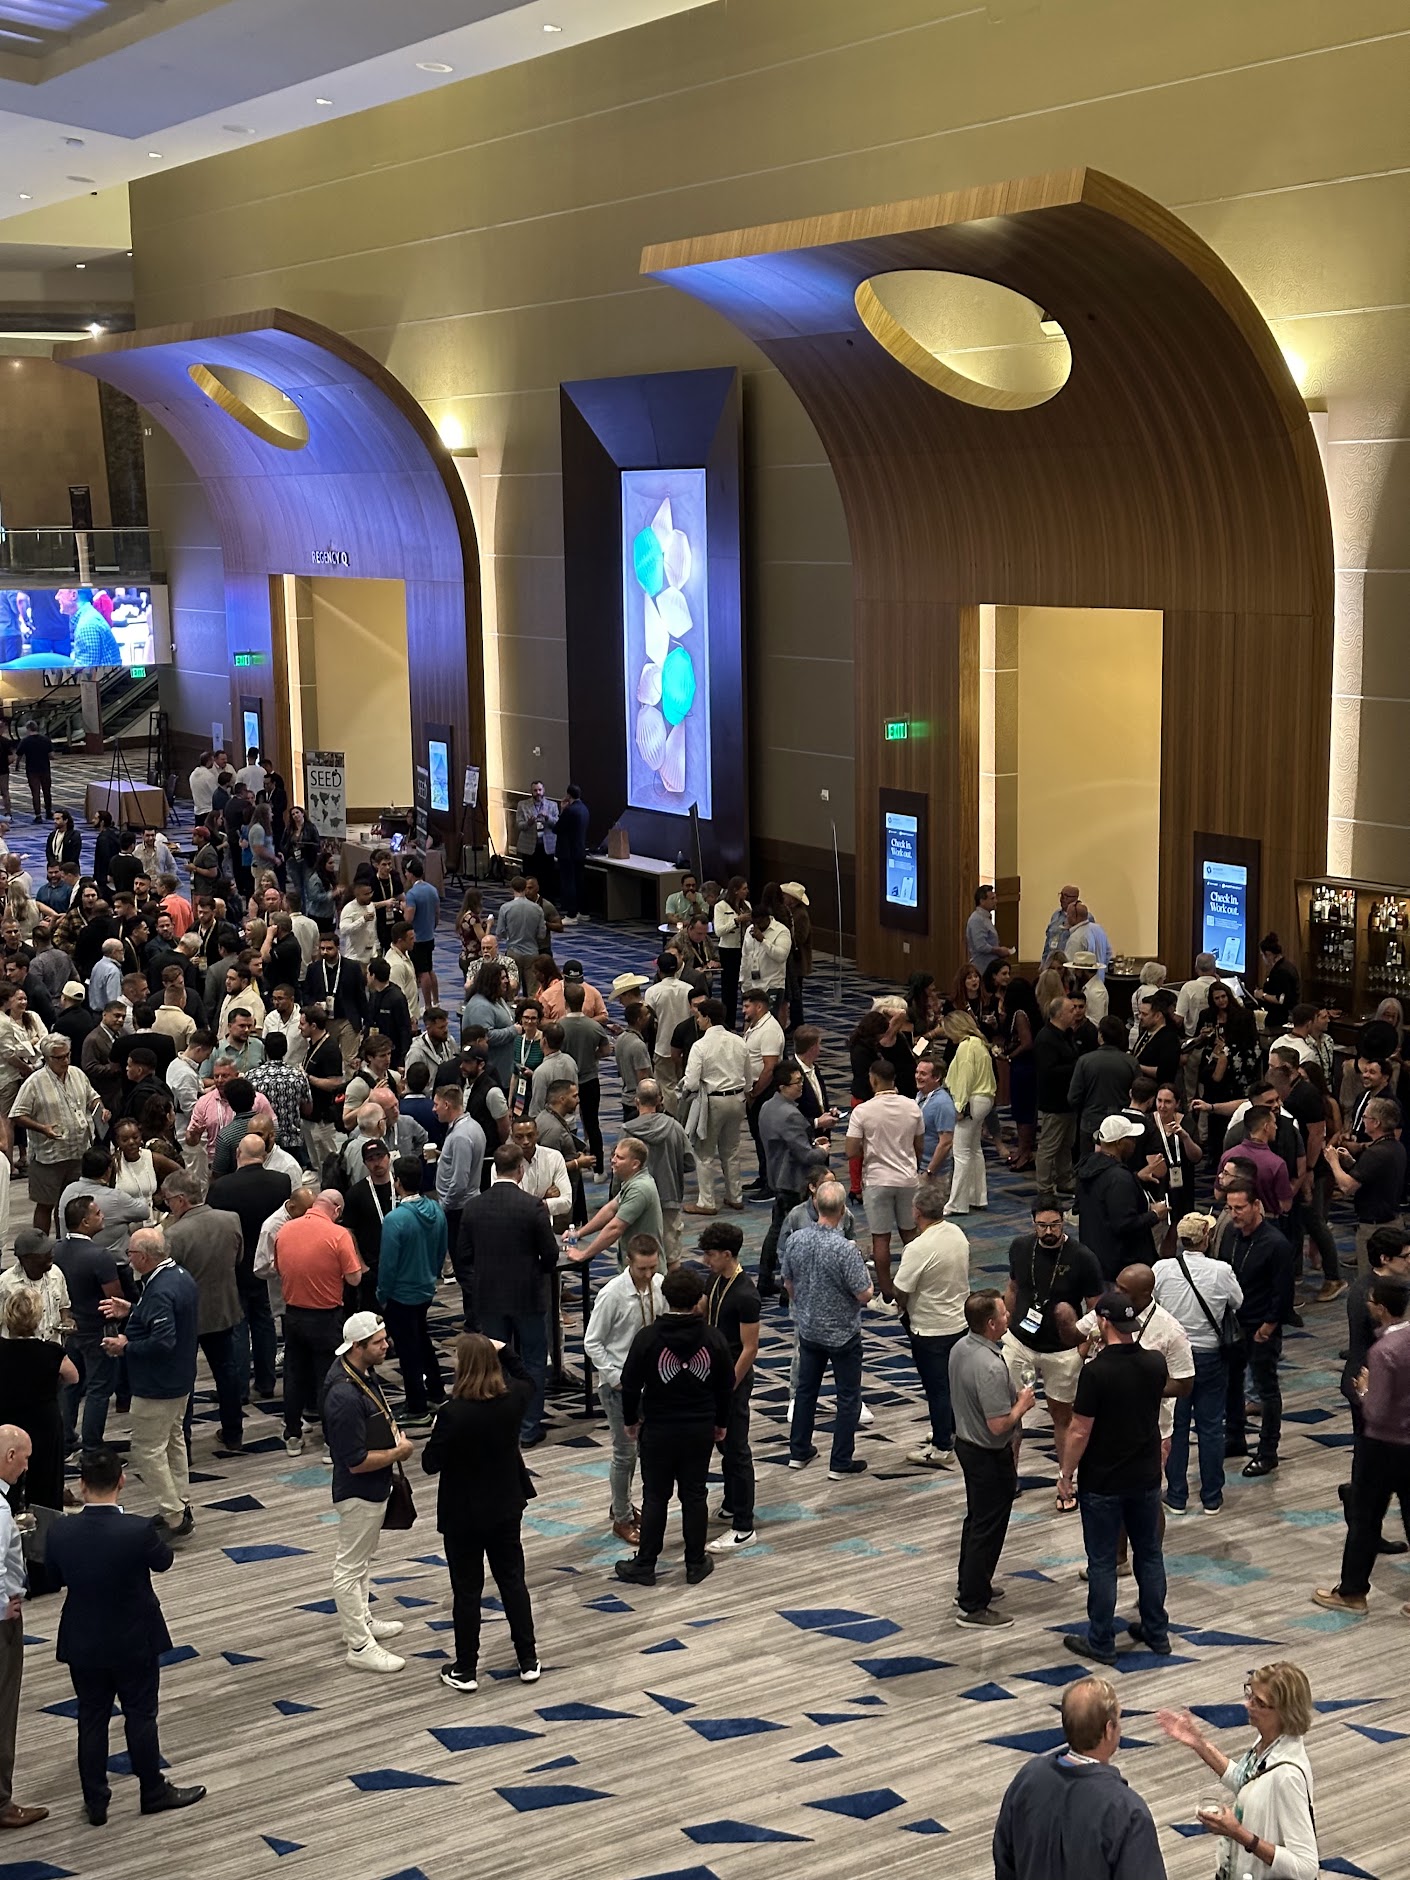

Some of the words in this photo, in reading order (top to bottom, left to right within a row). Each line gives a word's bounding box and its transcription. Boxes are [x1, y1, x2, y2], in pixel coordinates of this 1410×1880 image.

[312, 551, 340, 564] REGENCY
[341, 551, 350, 567] Q
[888, 723, 905, 738] EXIT
[311, 770, 342, 787] SEED
[891, 839, 905, 848] Check
[891, 848, 904, 858] Work
[1210, 891, 1230, 903] Check
[1230, 895, 1239, 905] in.
[1210, 902, 1227, 914] Work
[1227, 906, 1239, 915] out.
